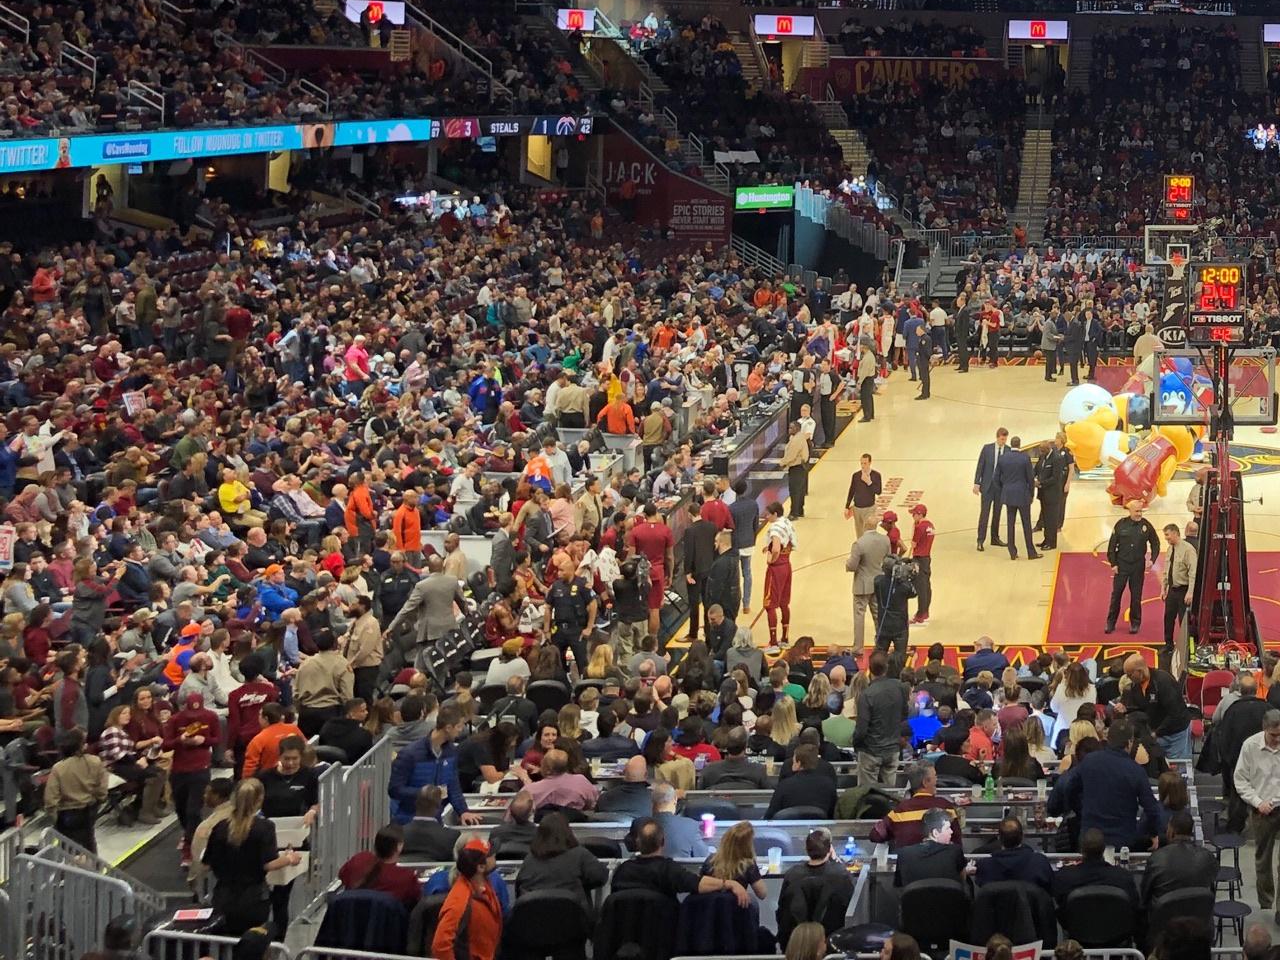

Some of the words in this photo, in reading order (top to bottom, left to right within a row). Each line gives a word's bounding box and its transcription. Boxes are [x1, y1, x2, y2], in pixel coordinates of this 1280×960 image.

[464, 121, 472, 136] 3
[490, 122, 519, 133] STEALS
[605, 160, 657, 185] JACK
[1170, 178, 1191, 188] 12:00
[1169, 187, 1188, 201] 24
[673, 205, 691, 216] EPIC
[692, 205, 725, 217] STORIES
[1202, 268, 1239, 283] 12:00
[1200, 284, 1235, 310] 24
[1207, 315, 1243, 324] TISSOT
[1163, 330, 1186, 341] KIA
